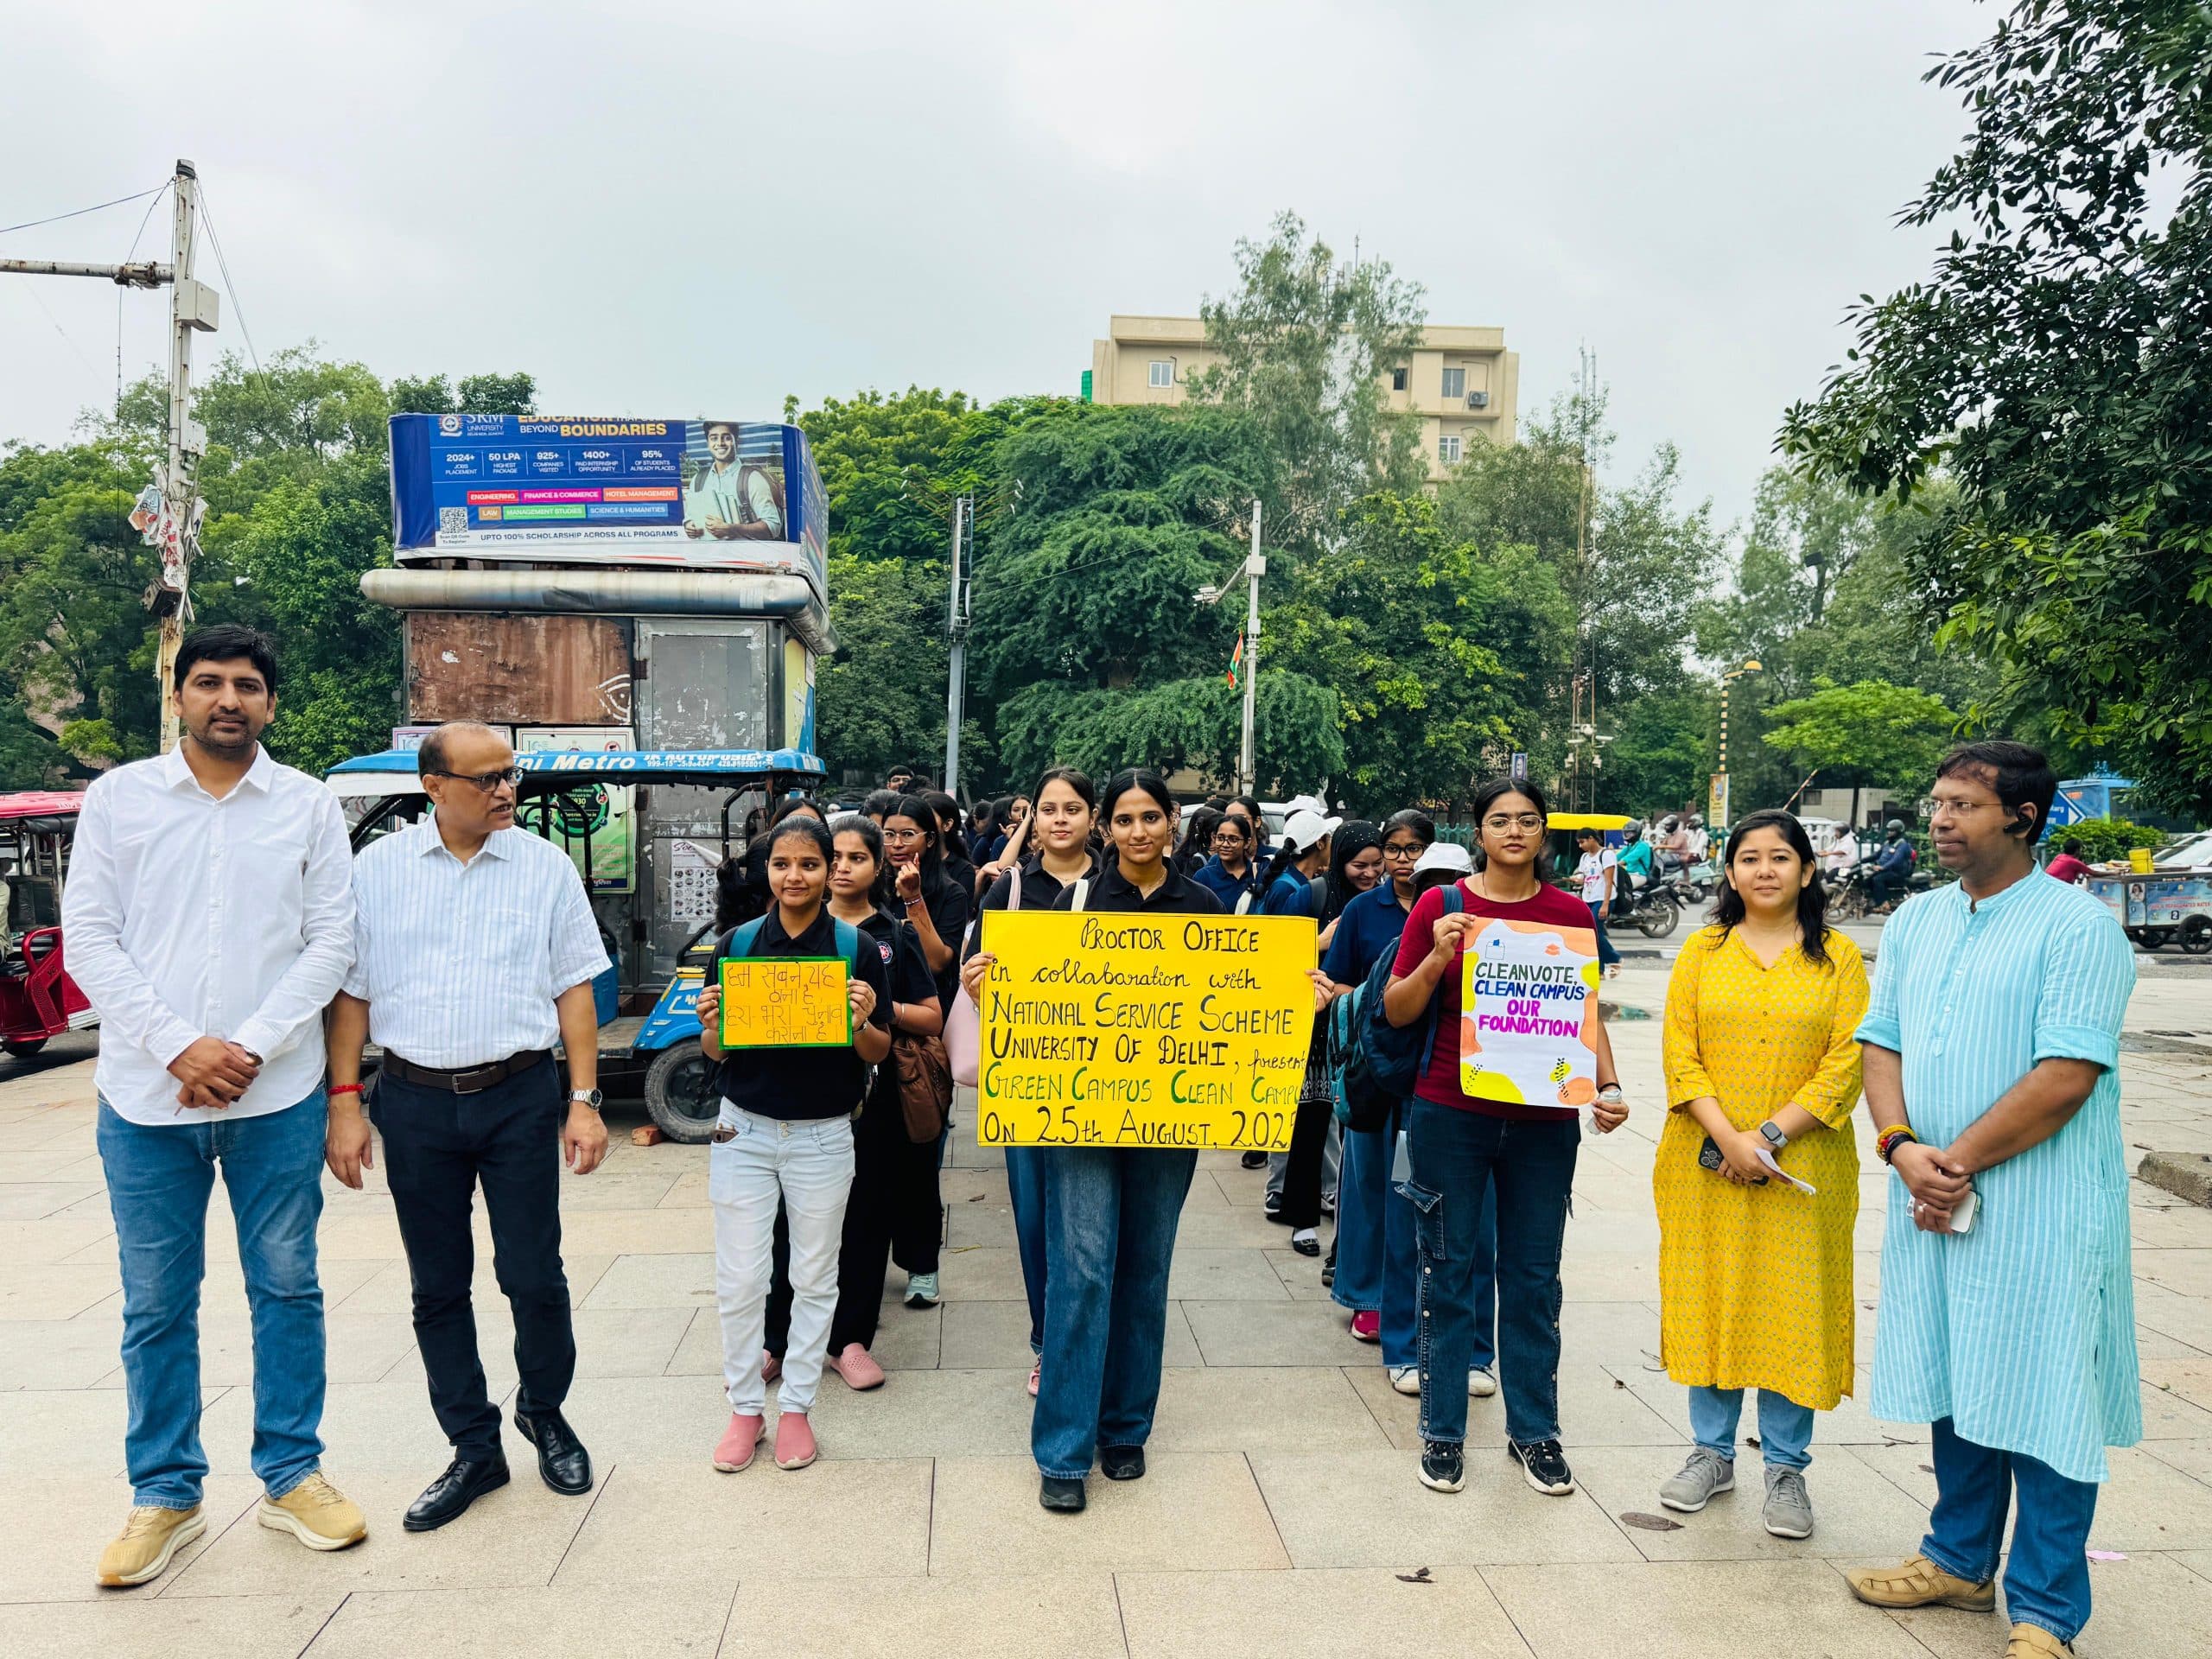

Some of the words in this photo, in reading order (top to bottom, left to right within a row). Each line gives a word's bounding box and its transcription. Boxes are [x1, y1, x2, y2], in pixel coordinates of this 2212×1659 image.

[520, 424, 559, 433] BEYOND
[560, 423, 667, 437] BOUNDARIES
[446, 454, 475, 462] 2024+
[502, 453, 521, 461] LPA
[537, 452, 560, 461] 925+
[525, 531, 582, 540] SCHOLARSHIP
[551, 755, 636, 770] Metro
[1080, 917, 1166, 950] PROCTOR
[1183, 921, 1260, 952] OFFICE
[728, 965, 751, 988] हम
[806, 964, 836, 988] यह
[990, 958, 1012, 982] in
[1209, 969, 1262, 990] with
[1474, 979, 1528, 998] CLEAN
[1529, 982, 1586, 1001] CAMPUS
[988, 990, 1086, 1027] NATIONAL
[1095, 992, 1184, 1030] SERVICE
[1198, 994, 1294, 1035] SCHEME
[1506, 999, 1541, 1017] OUR
[1478, 1014, 1579, 1038] FOUNDATION
[990, 1027, 1099, 1063] UNIVERSITY
[1115, 1033, 1142, 1064] OF
[985, 1061, 1063, 1101] GREEN
[1071, 1066, 1153, 1103] CAMPUS
[1171, 1069, 1233, 1105] CLEAN
[984, 1111, 1015, 1142] ON
[1037, 1105, 1104, 1145] 25th
